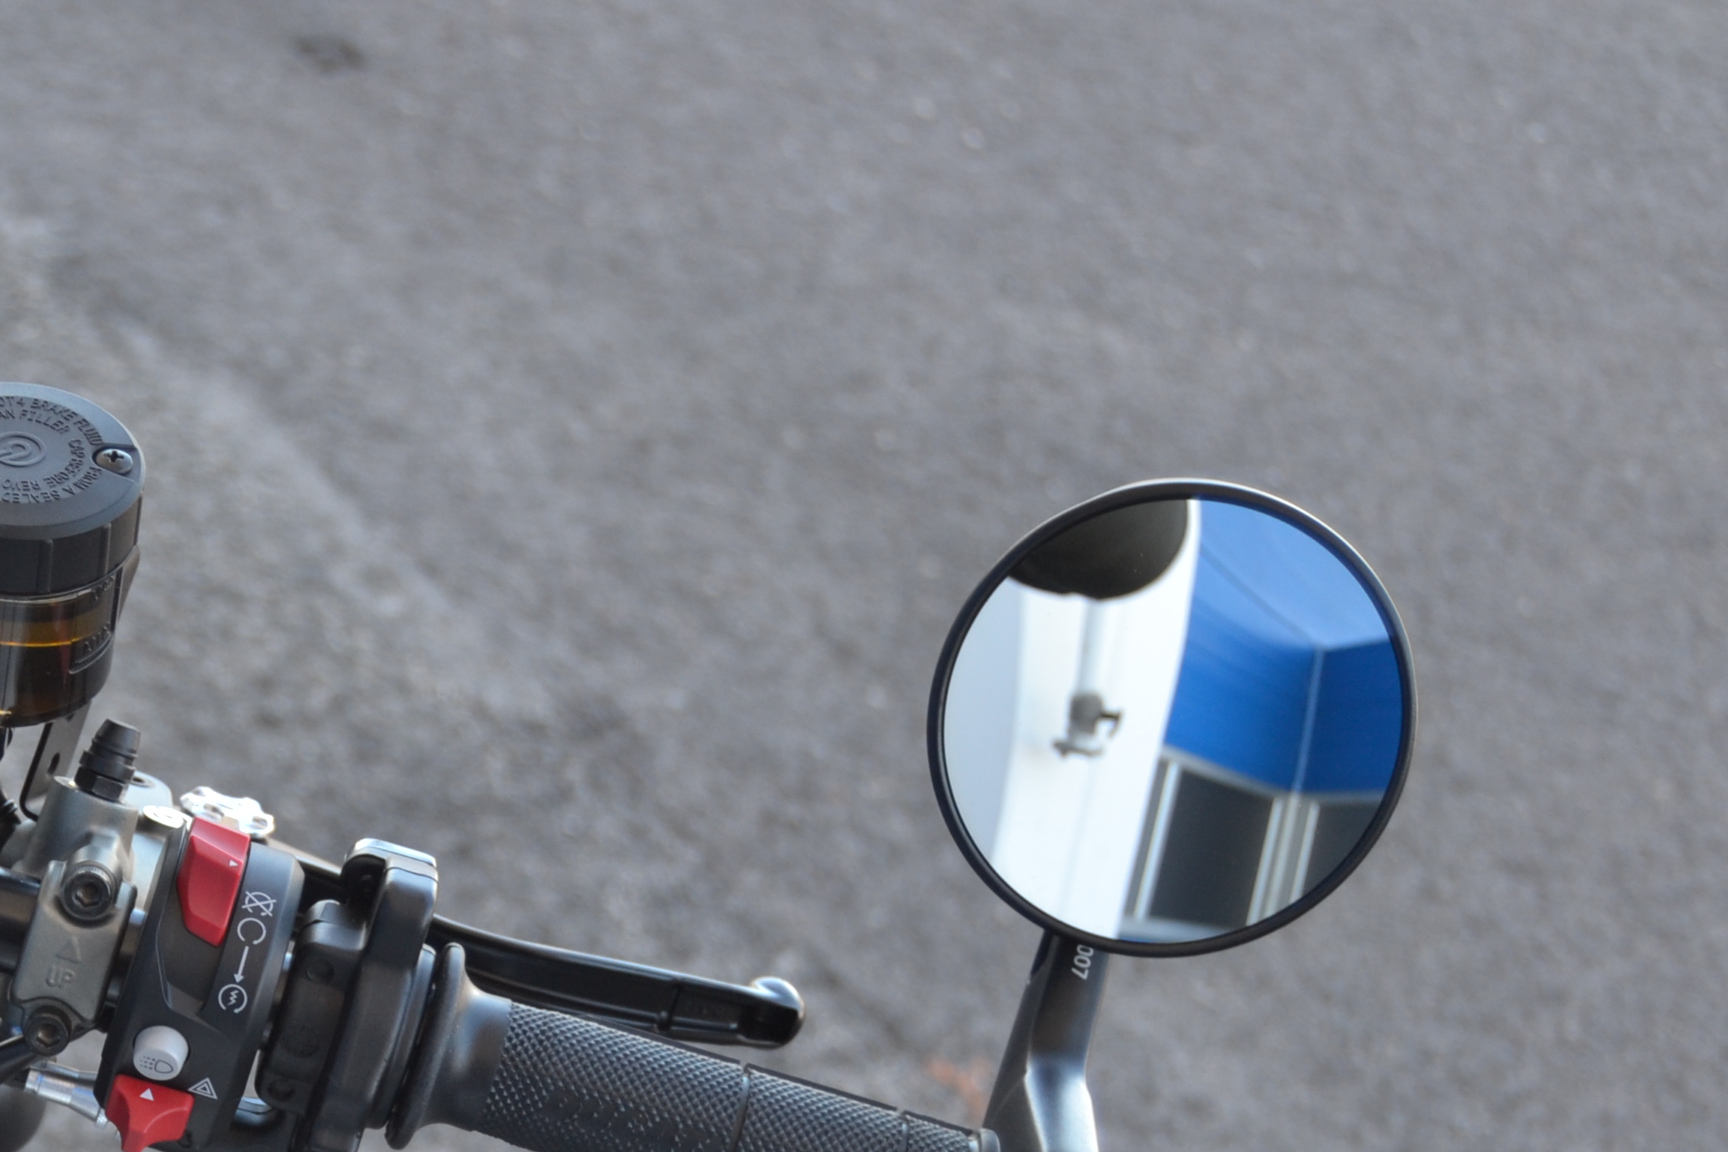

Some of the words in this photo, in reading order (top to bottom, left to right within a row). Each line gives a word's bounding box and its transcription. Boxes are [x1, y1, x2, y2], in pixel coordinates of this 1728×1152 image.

[18, 409, 70, 435] FILLER
[29, 398, 78, 422] BRAKE
[73, 418, 104, 446] FLUID
[1, 489, 61, 505] SEALED
[45, 965, 77, 989] UP
